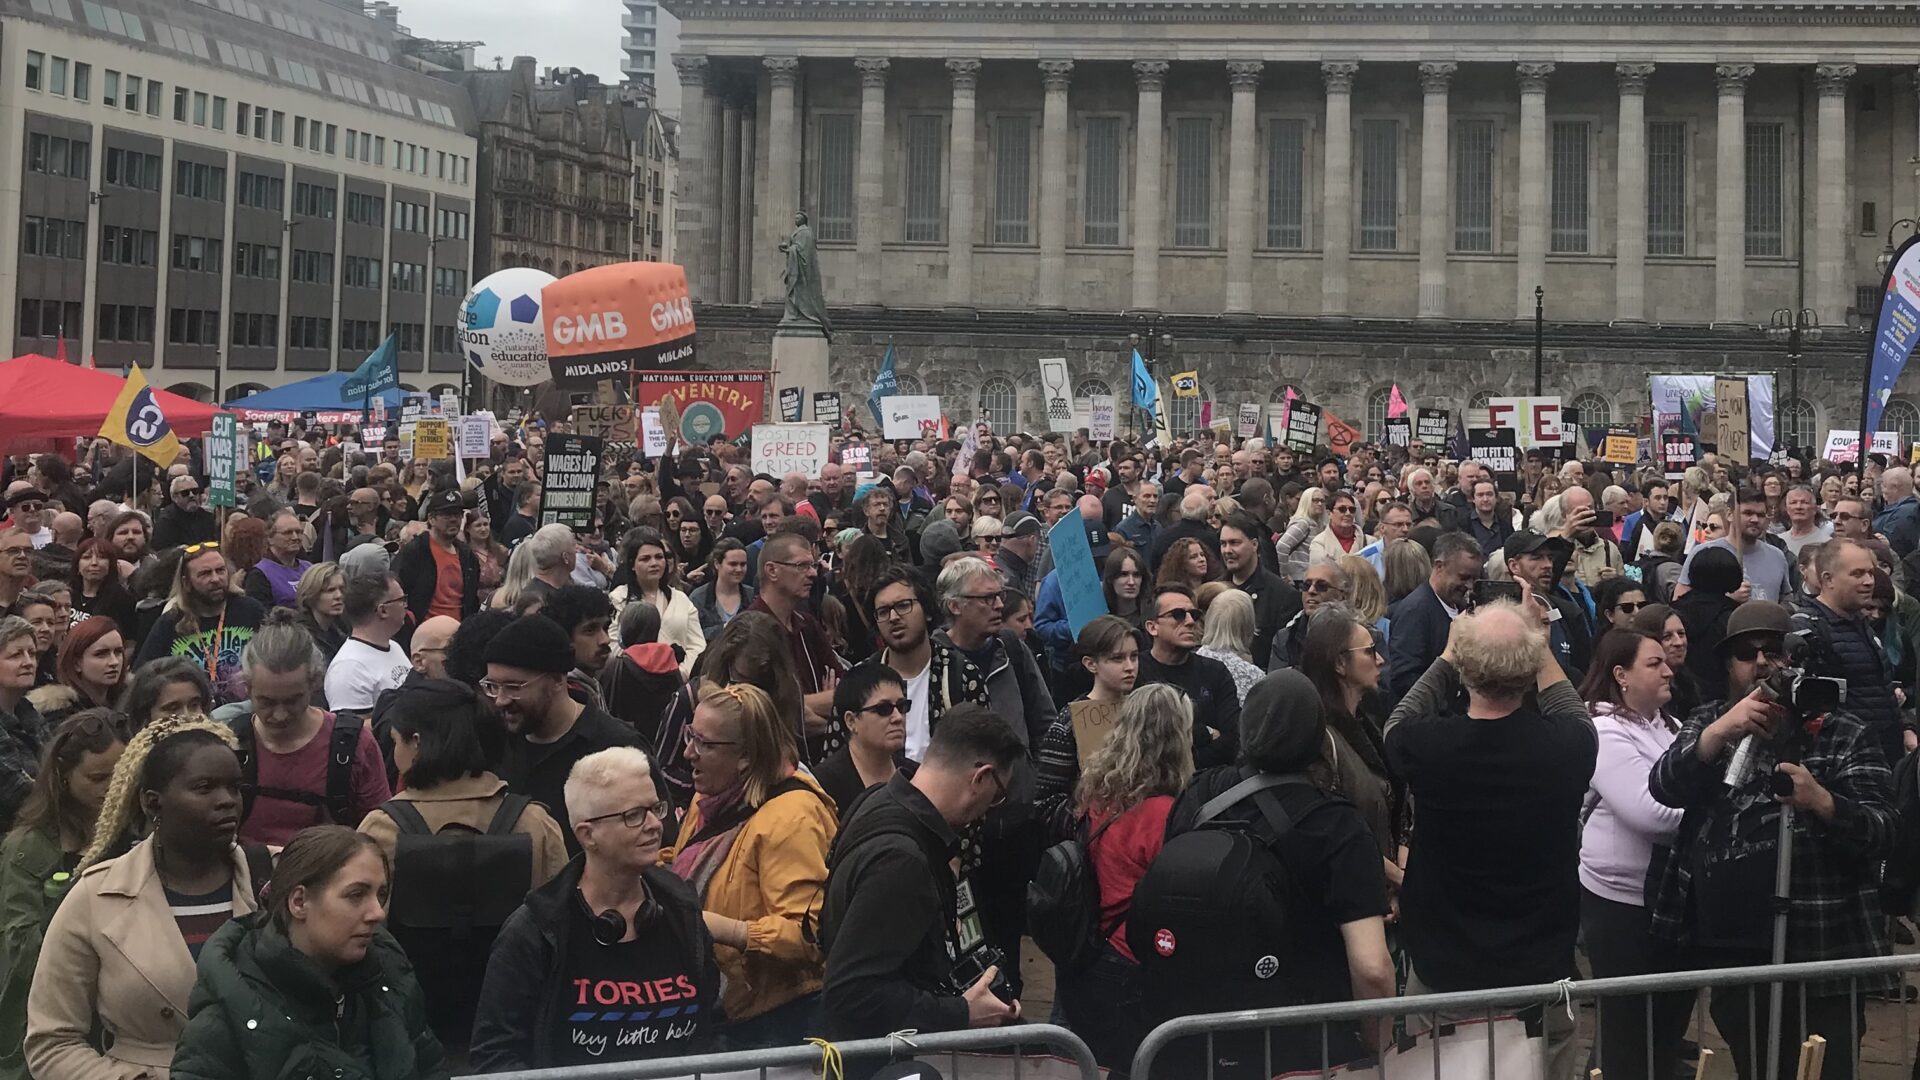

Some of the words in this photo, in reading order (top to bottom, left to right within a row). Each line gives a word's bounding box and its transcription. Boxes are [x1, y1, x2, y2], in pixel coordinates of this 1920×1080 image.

[650, 296, 694, 332] GMB
[553, 311, 628, 345] GMB
[505, 344, 538, 352] national
[658, 344, 694, 364] MIDLANDS
[510, 360, 532, 368] union
[565, 360, 628, 377] MIDLANDS
[643, 374, 685, 383] NATIONAL
[689, 374, 734, 383] EDUCATION
[738, 374, 763, 382] UNION
[652, 383, 753, 412] VENTRY
[1665, 389, 1696, 398] UNISON
[245, 410, 290, 422] Socialist
[293, 411, 338, 423] Wkers
[212, 416, 232, 437] CUT
[363, 427, 387, 436] STOP
[419, 421, 445, 429] SUPPORT
[757, 430, 794, 441] COST
[799, 429, 816, 440] OF
[211, 438, 232, 458] WAR
[763, 442, 817, 457] GREED
[842, 447, 869, 459] STOP
[1472, 447, 1488, 457] NOT
[1489, 447, 1501, 457] FIT
[1502, 447, 1514, 457] TO
[1666, 443, 1694, 454] STOP
[211, 458, 232, 479] NOT
[549, 454, 581, 472] WAGES
[582, 450, 597, 472] UP
[755, 459, 817, 475] CRISIS!
[546, 473, 569, 488] BILLS
[569, 473, 595, 490] DOWN
[547, 491, 574, 507] TORIES
[574, 491, 592, 507] OUT
[573, 974, 697, 1005] TORIES
[572, 1027, 607, 1056] Very
[616, 1026, 659, 1047] little
